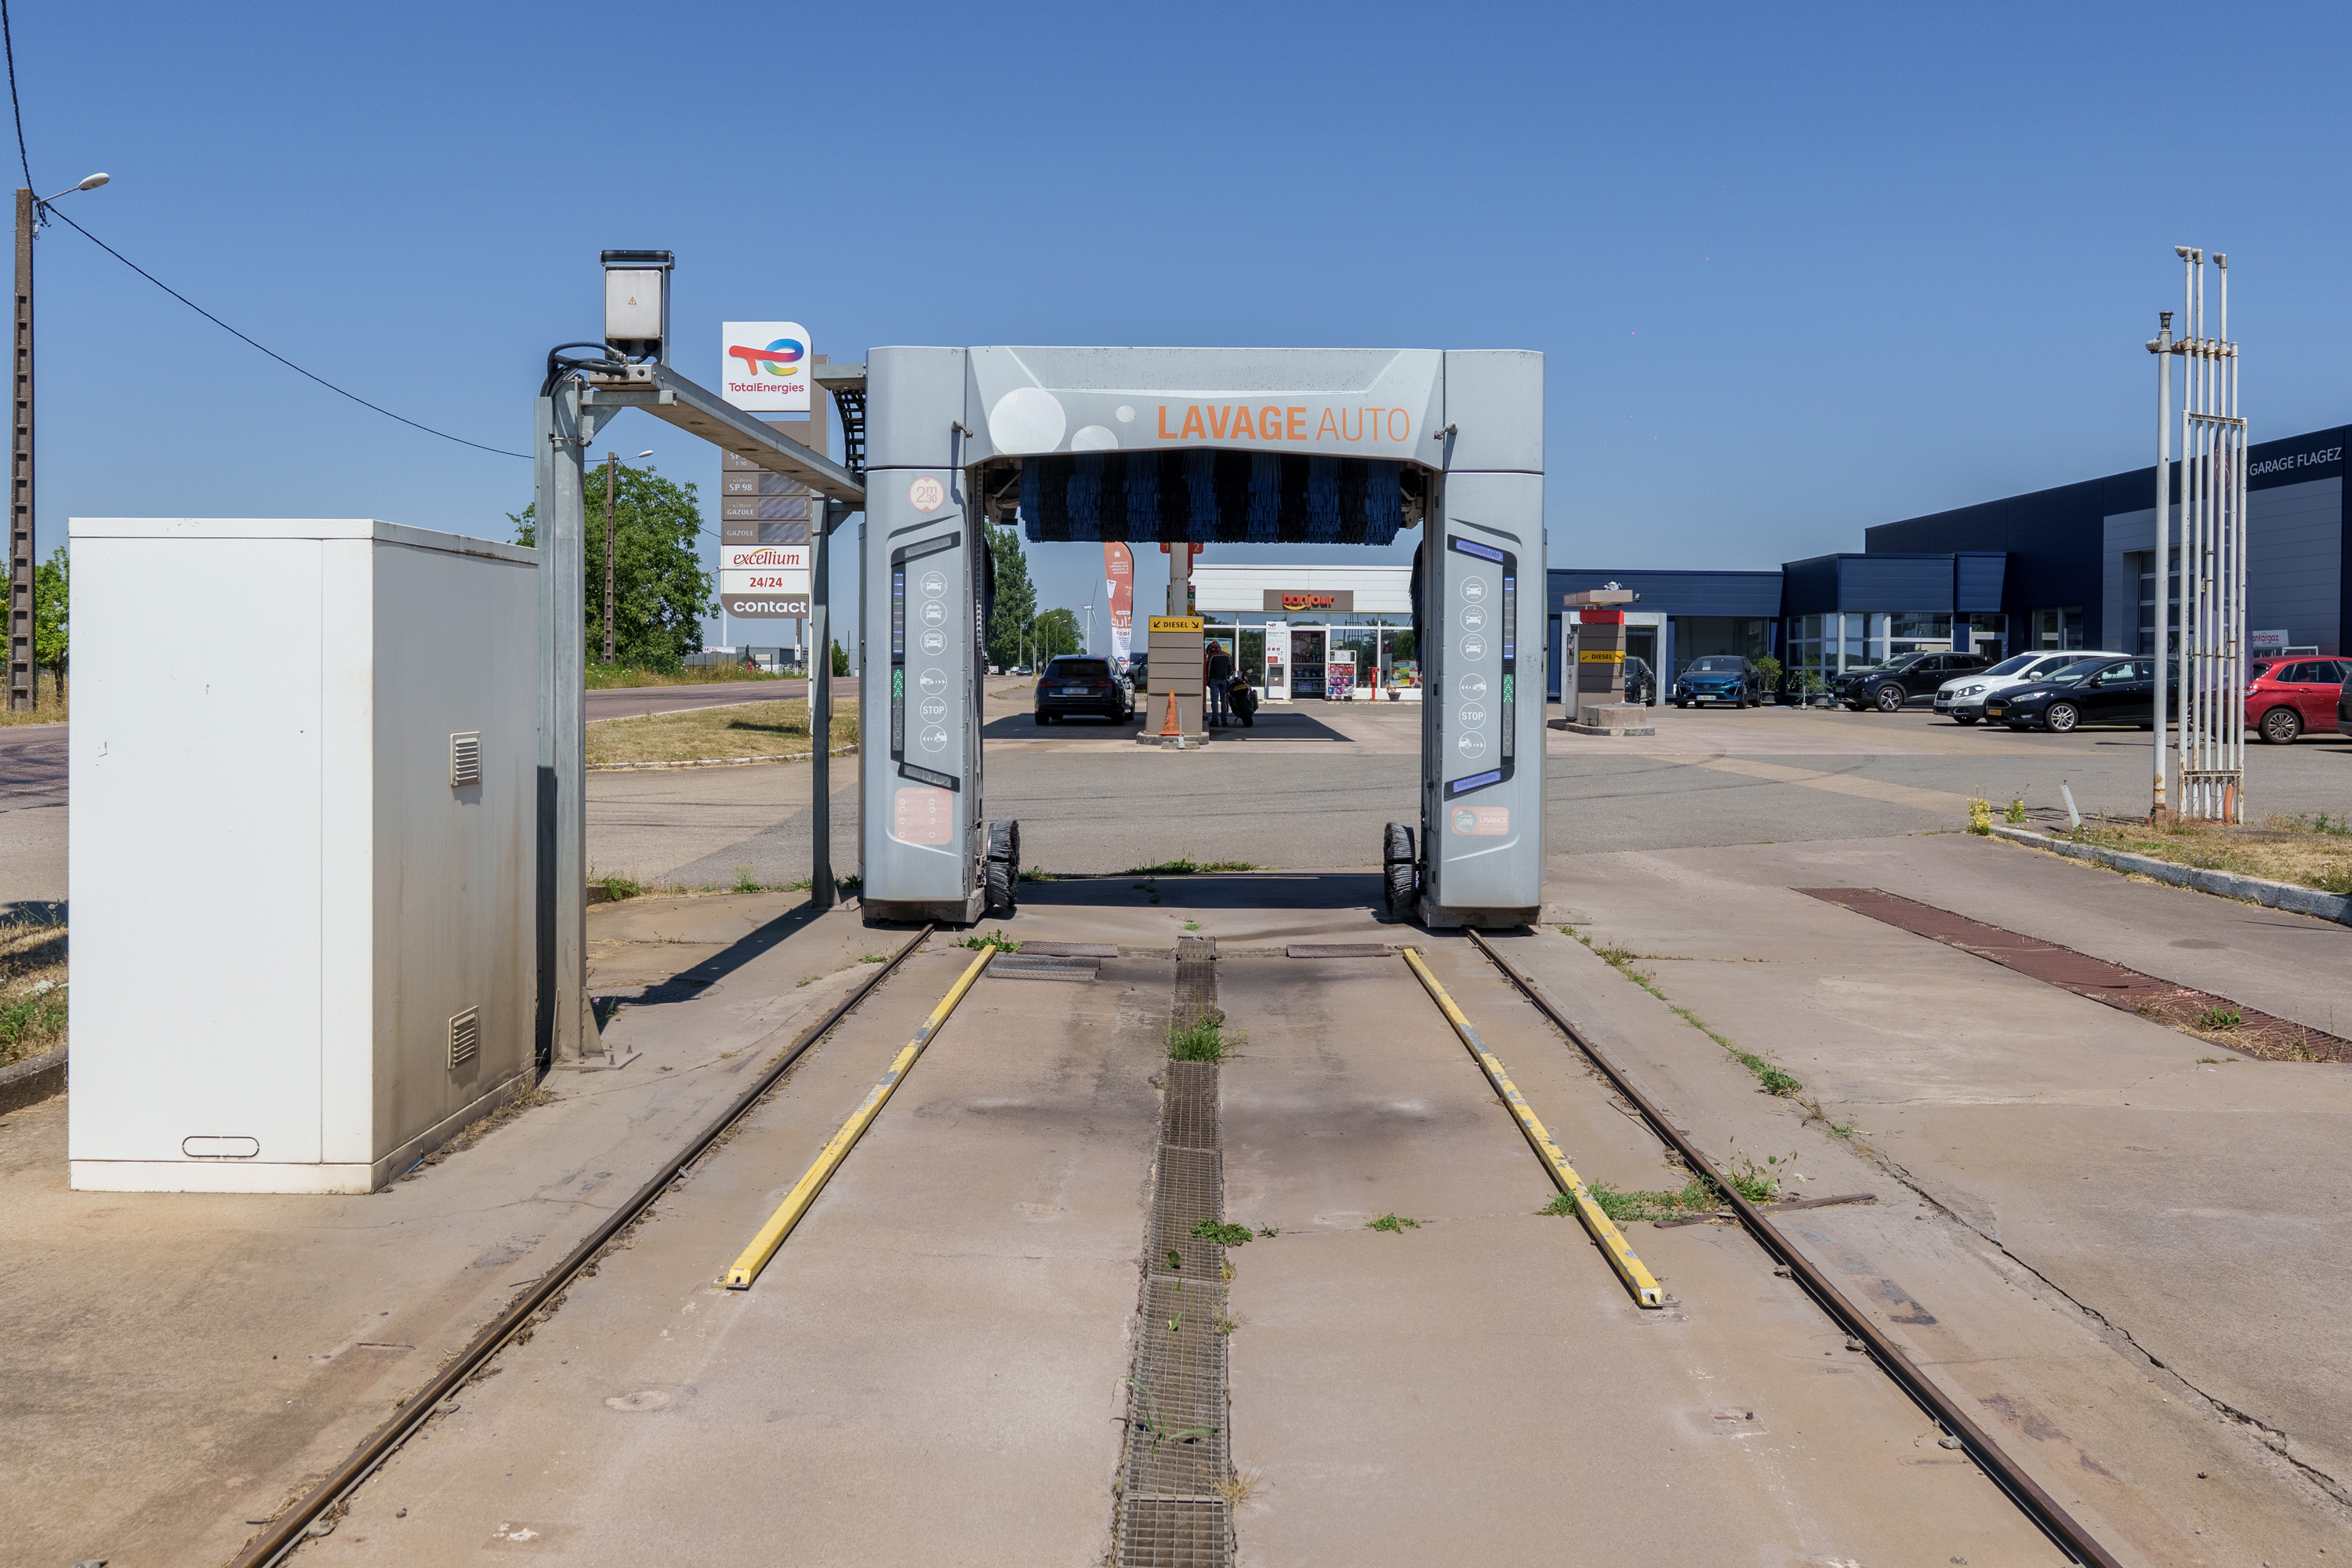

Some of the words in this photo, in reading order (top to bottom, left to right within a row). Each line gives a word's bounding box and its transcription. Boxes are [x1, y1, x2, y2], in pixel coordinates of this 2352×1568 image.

[728, 383, 804, 394] TotalEnergies
[1158, 405, 1308, 441] LAVAGE
[1316, 407, 1410, 442] AUTO
[2249, 456, 2295, 476] GARAGE
[2297, 447, 2343, 467] FLAGEZ
[729, 483, 740, 492] SP
[742, 483, 753, 492] 98
[1193, 543, 1200, 552] 2
[733, 550, 800, 564] excellium
[750, 577, 783, 587] 24/24
[1283, 592, 1335, 608] bonjour
[733, 601, 807, 613] contact
[923, 706, 945, 714] STOP
[1461, 711, 1483, 720] STOP
